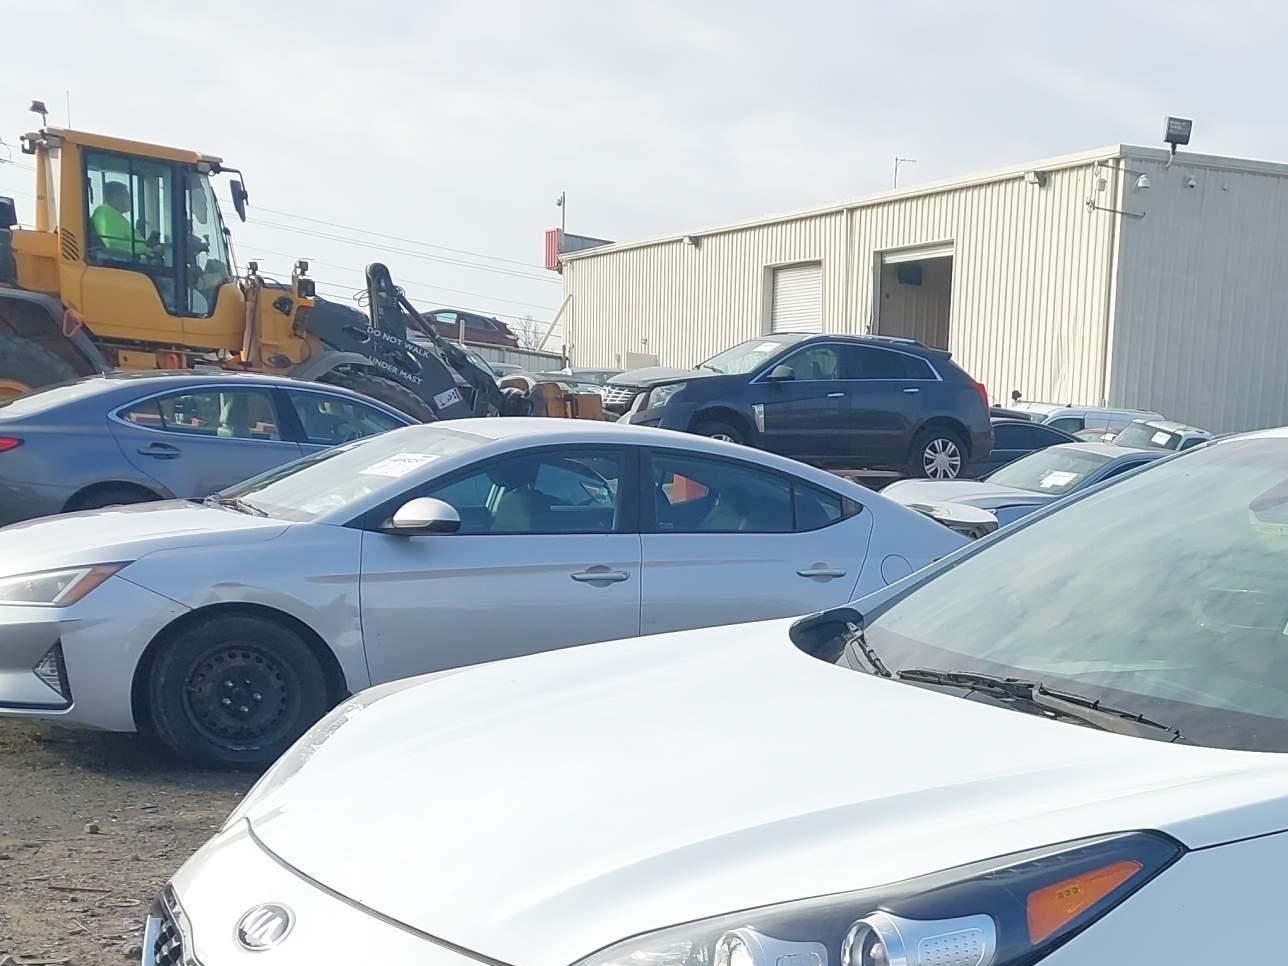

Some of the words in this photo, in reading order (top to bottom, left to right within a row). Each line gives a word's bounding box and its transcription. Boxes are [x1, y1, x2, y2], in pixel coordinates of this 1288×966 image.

[367, 326, 381, 337] DO
[382, 333, 402, 346] NOT
[404, 341, 430, 358] WALK
[368, 355, 399, 375] UNDER
[399, 370, 423, 385] MAST
